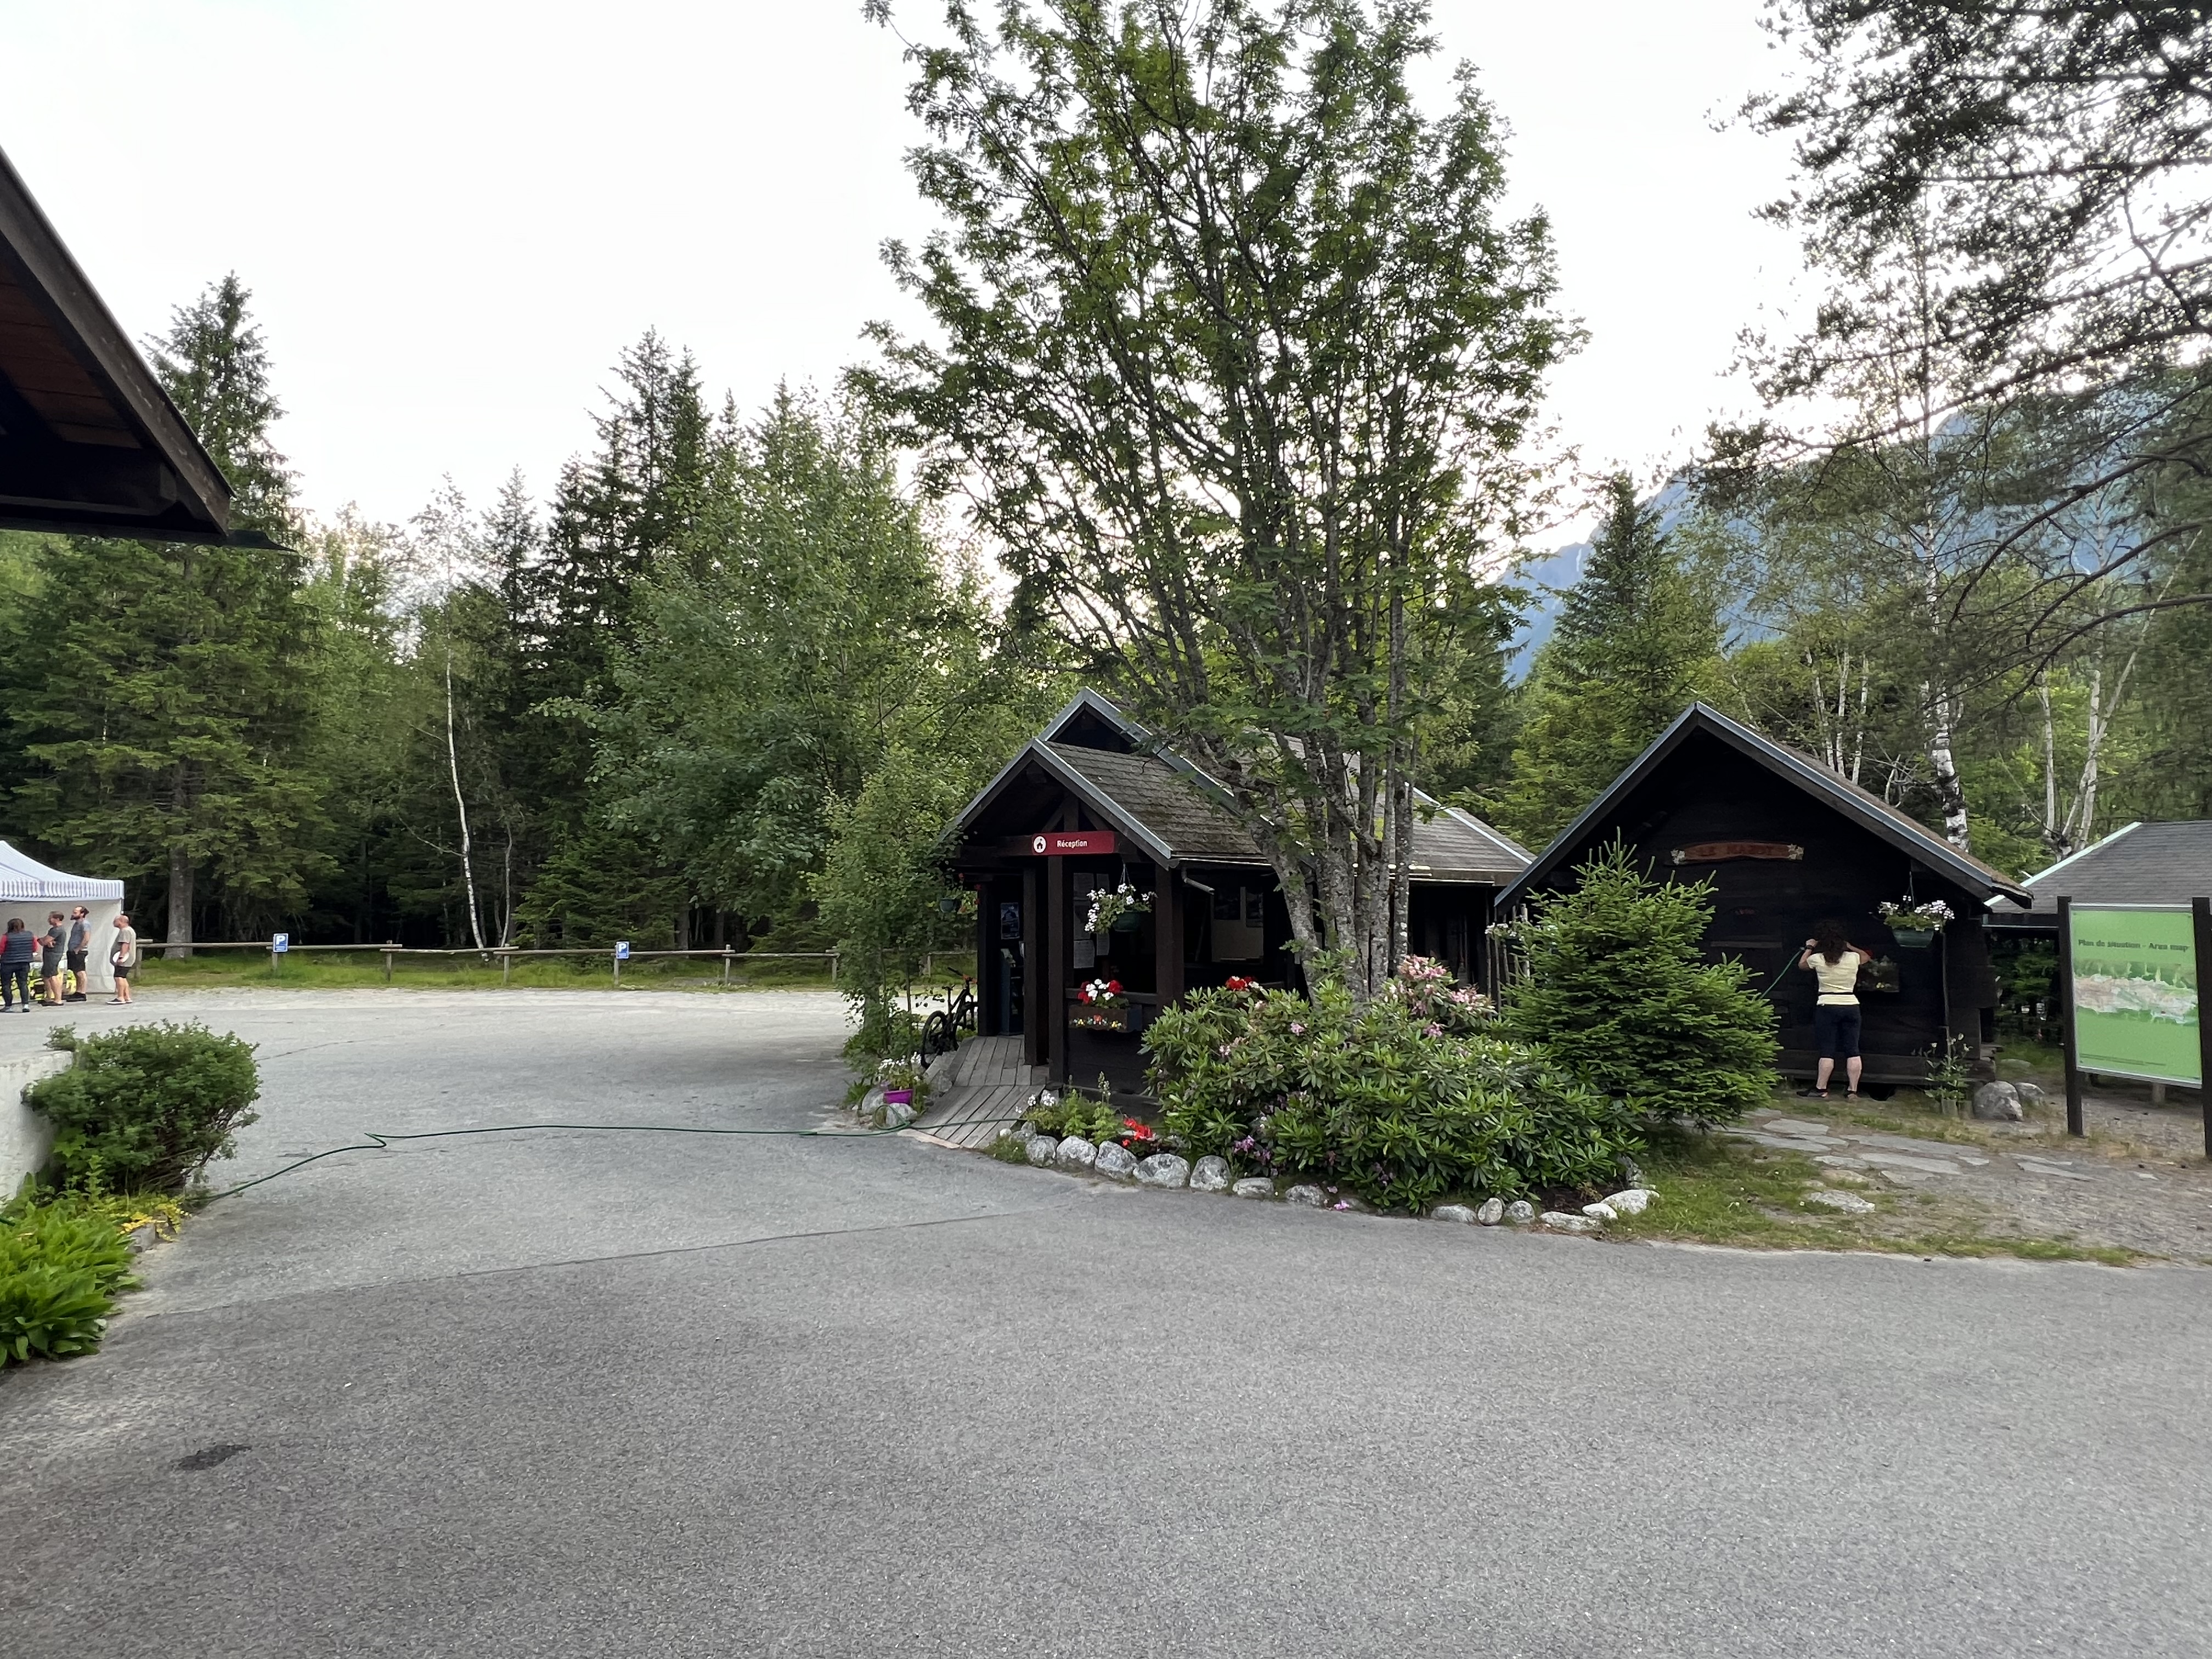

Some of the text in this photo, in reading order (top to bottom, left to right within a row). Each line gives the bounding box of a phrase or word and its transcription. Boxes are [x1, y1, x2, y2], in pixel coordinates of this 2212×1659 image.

[1057, 839, 1087, 849] Réception
[276, 935, 286, 945] P
[618, 943, 627, 952] P
